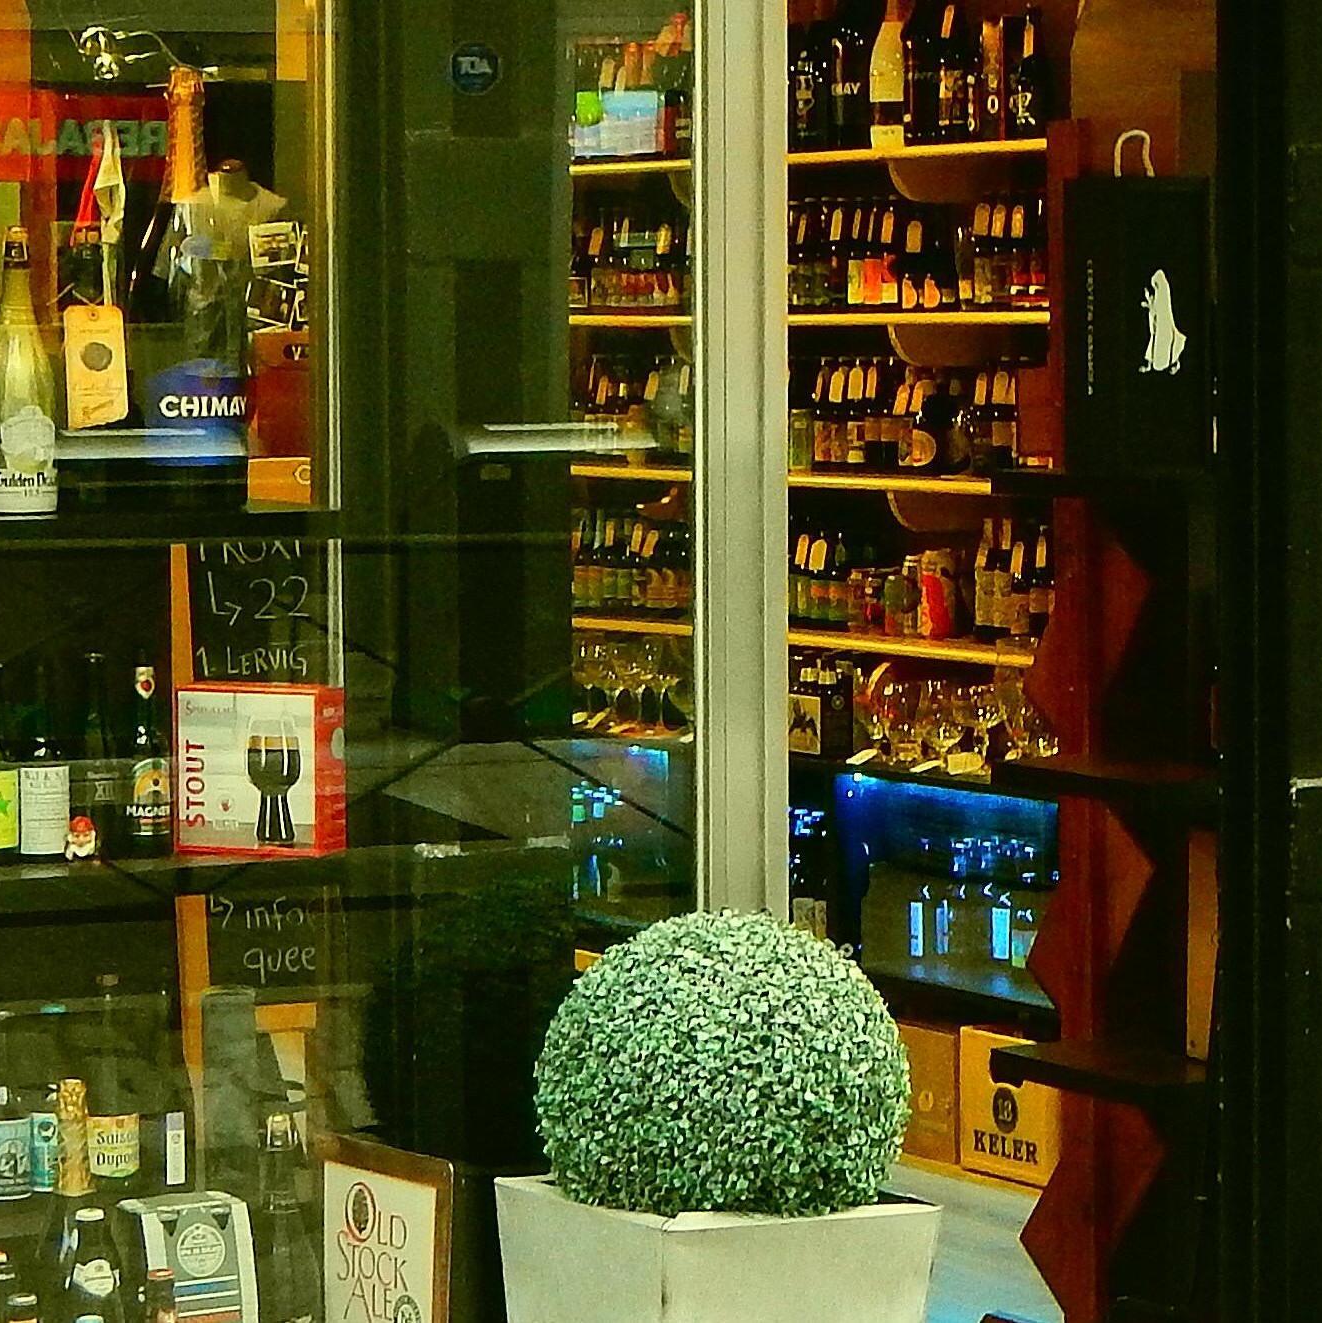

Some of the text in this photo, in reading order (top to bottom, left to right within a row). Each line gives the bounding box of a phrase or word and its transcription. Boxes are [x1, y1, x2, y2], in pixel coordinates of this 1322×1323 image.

[159, 395, 247, 417] CHIMAY
[249, 576, 309, 620] 22
[227, 644, 307, 677] LERVIG
[185, 739, 205, 827] STOUT
[973, 1129, 1038, 1166] KELER
[345, 1181, 407, 1249] OLD
[337, 1229, 408, 1292] STOCK
[343, 1274, 393, 1323] ALE
